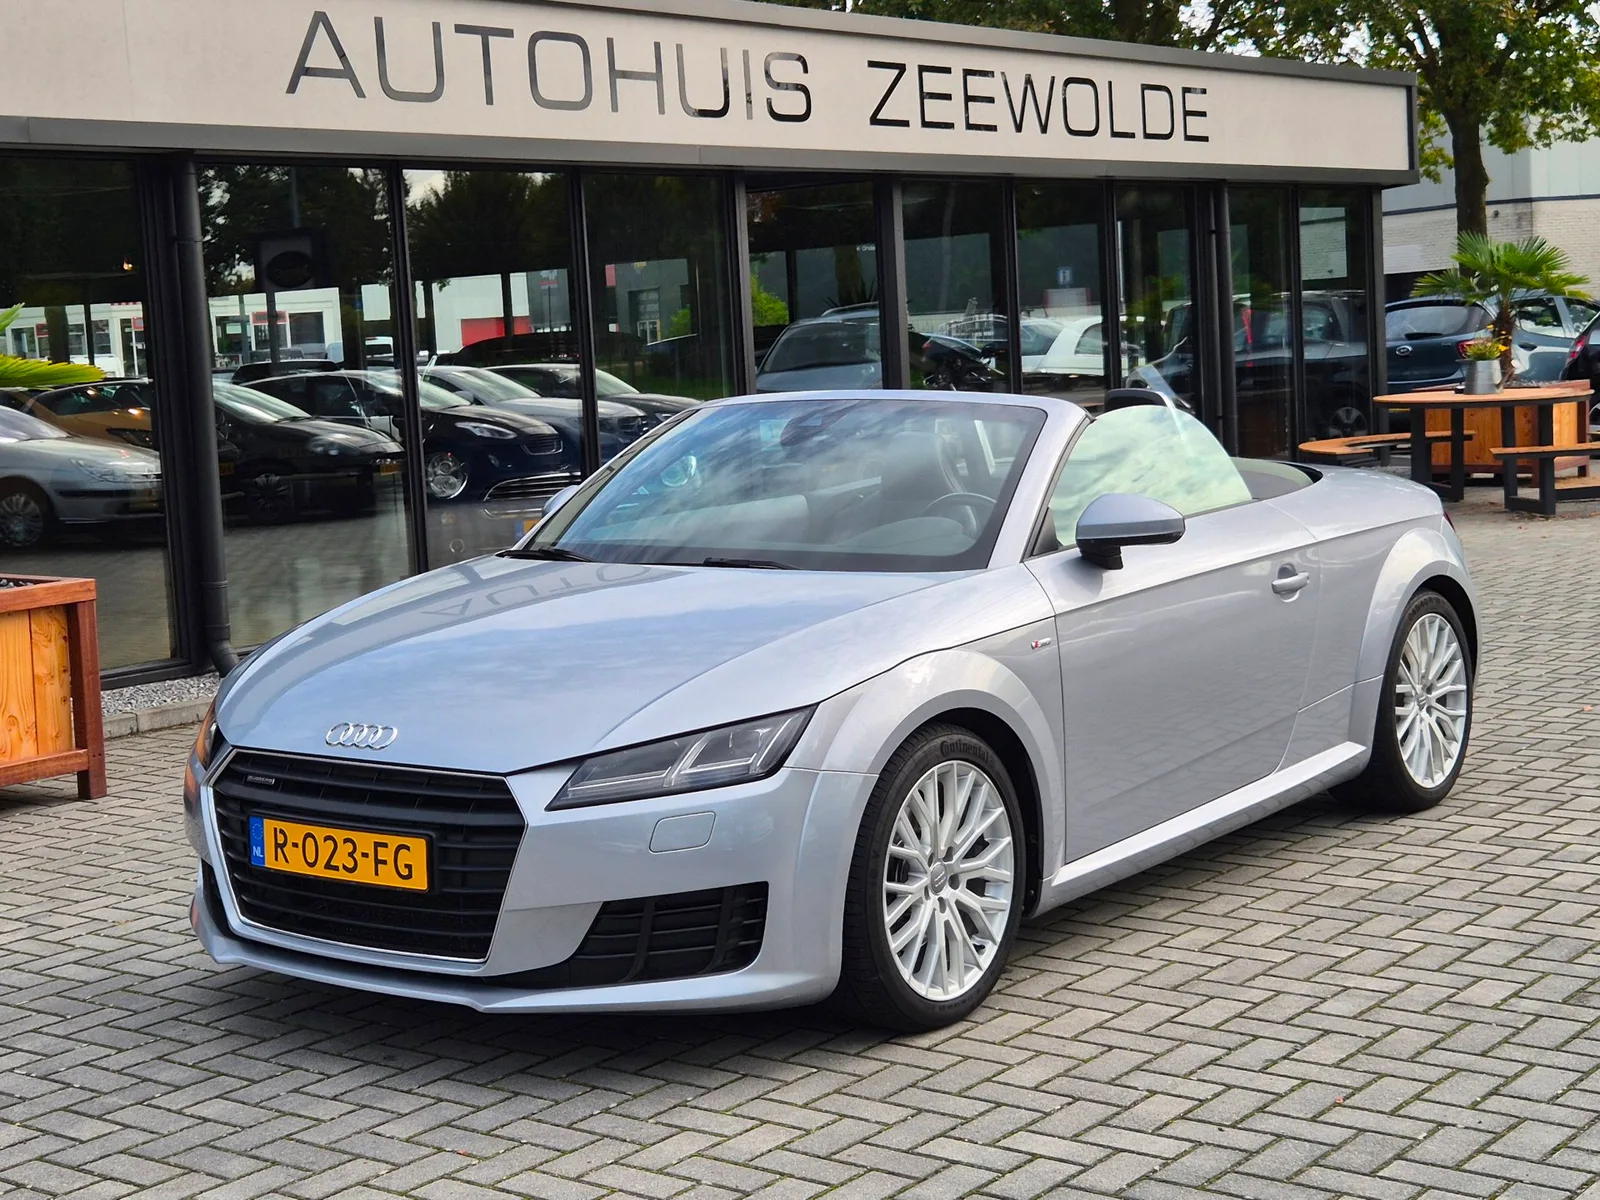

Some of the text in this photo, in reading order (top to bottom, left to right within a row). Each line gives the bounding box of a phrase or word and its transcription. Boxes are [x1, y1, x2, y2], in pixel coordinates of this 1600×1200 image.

[286, 11, 1209, 143] AUTOHUIS ZEEWOLDE
[940, 740, 989, 763] Continental
[252, 827, 413, 881] NL R-023-FG
